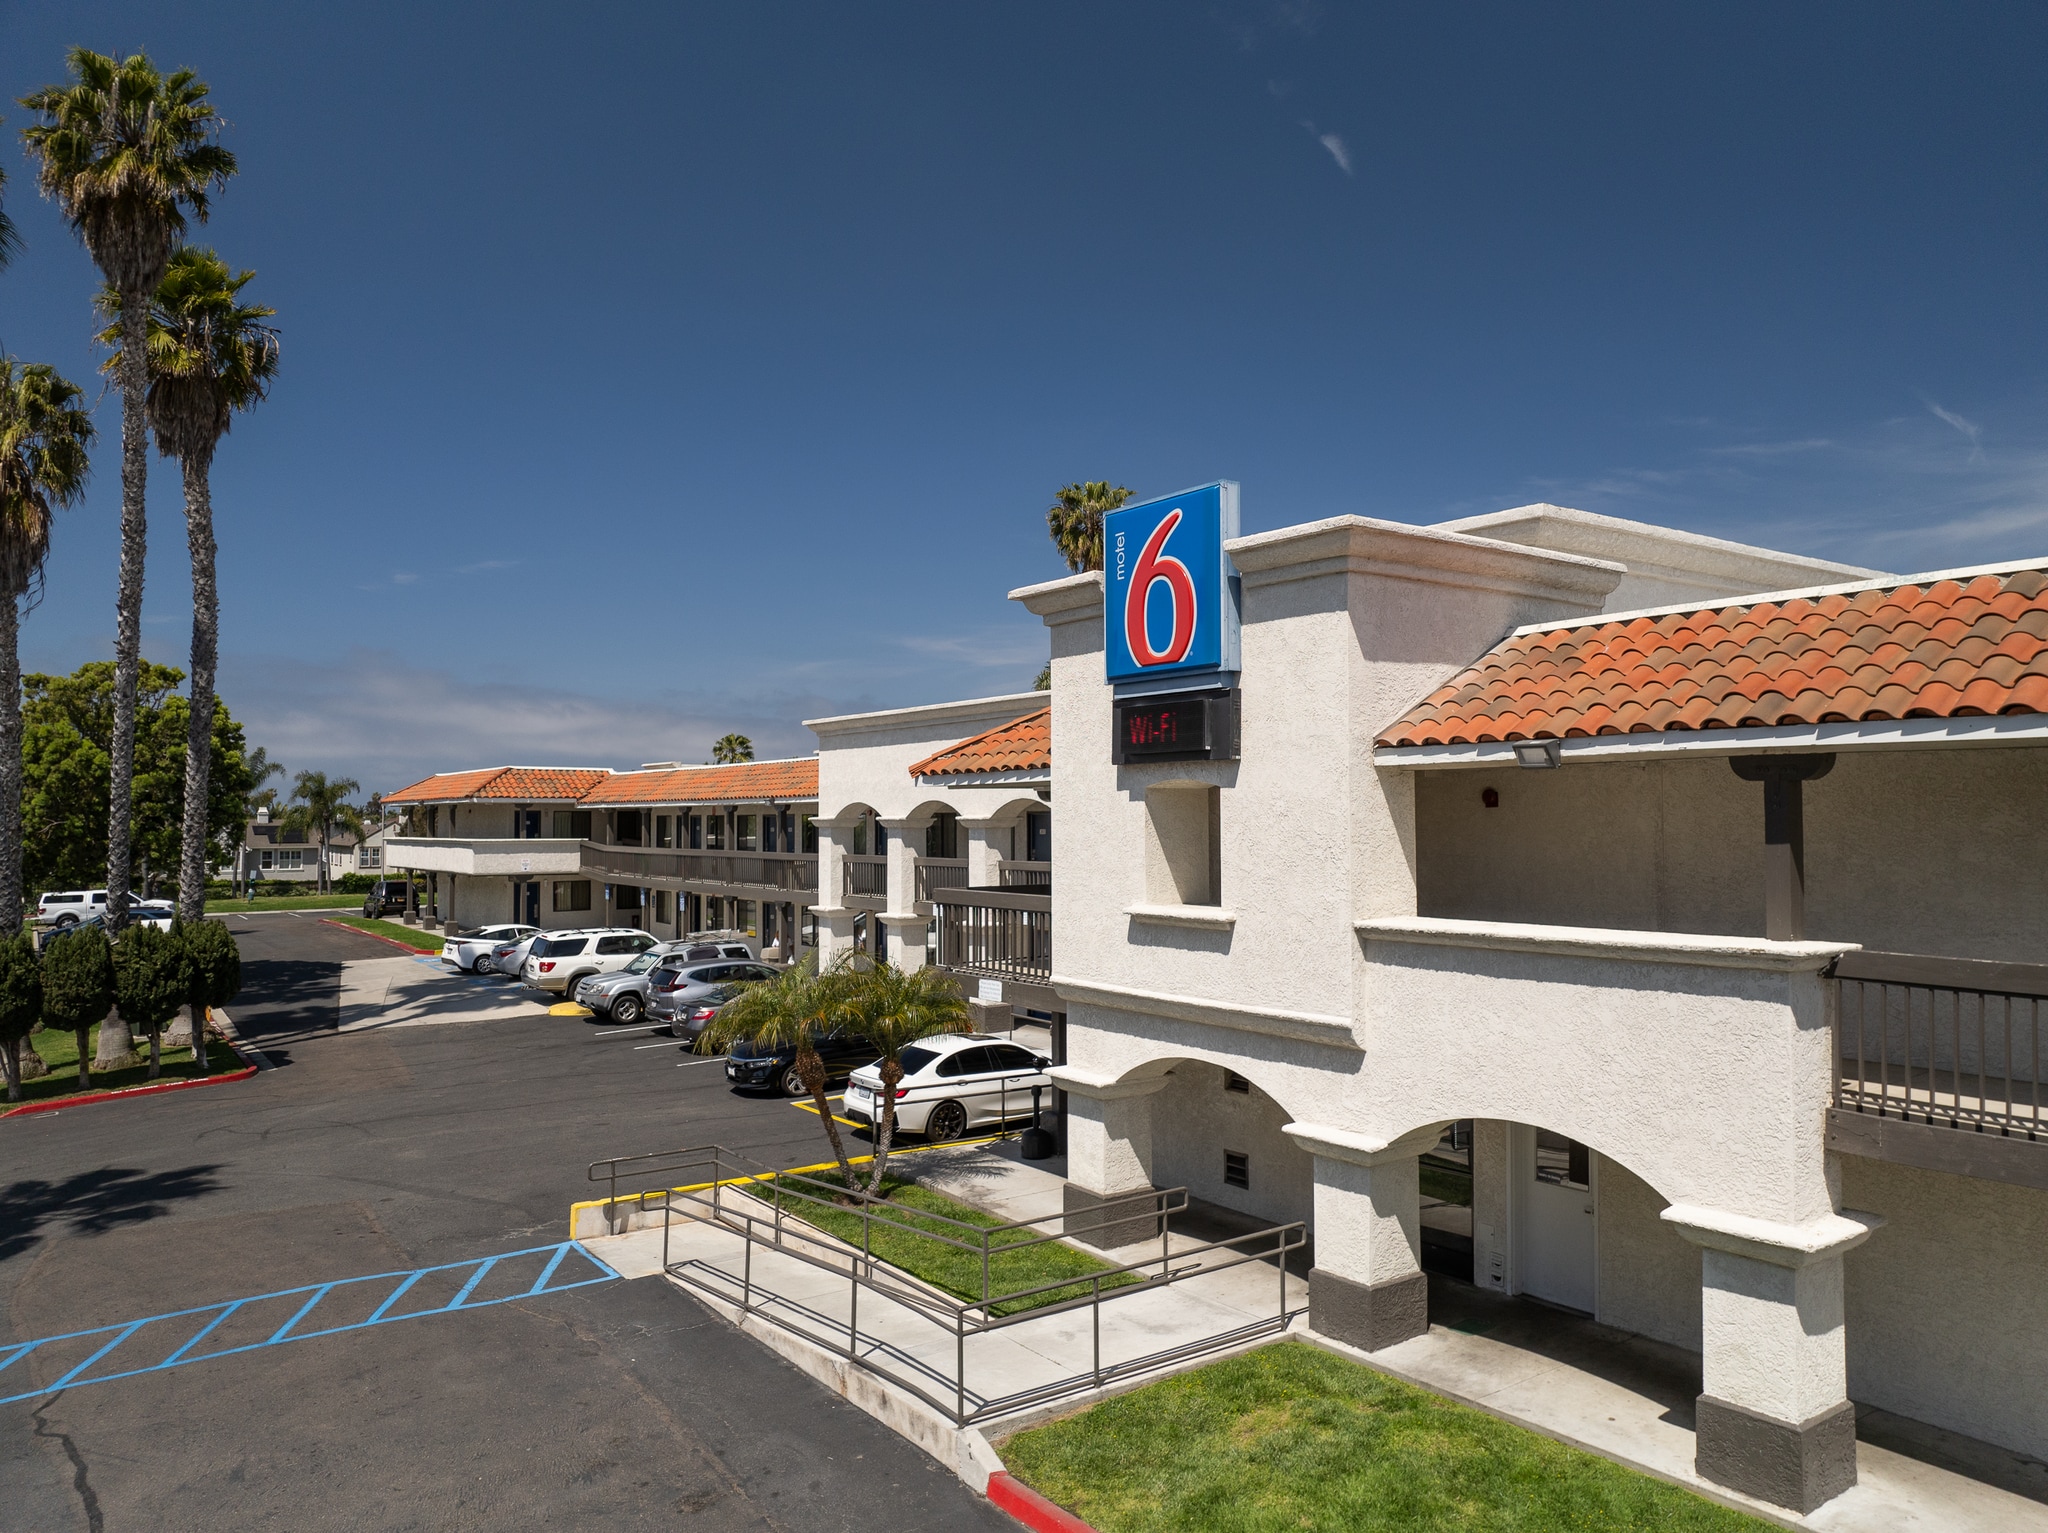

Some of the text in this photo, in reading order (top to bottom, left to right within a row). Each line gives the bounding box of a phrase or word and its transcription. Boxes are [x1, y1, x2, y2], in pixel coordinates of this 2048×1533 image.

[1115, 531, 1125, 580] motel
[1125, 508, 1197, 667] 6
[1130, 712, 1177, 744] Wi-Fi
